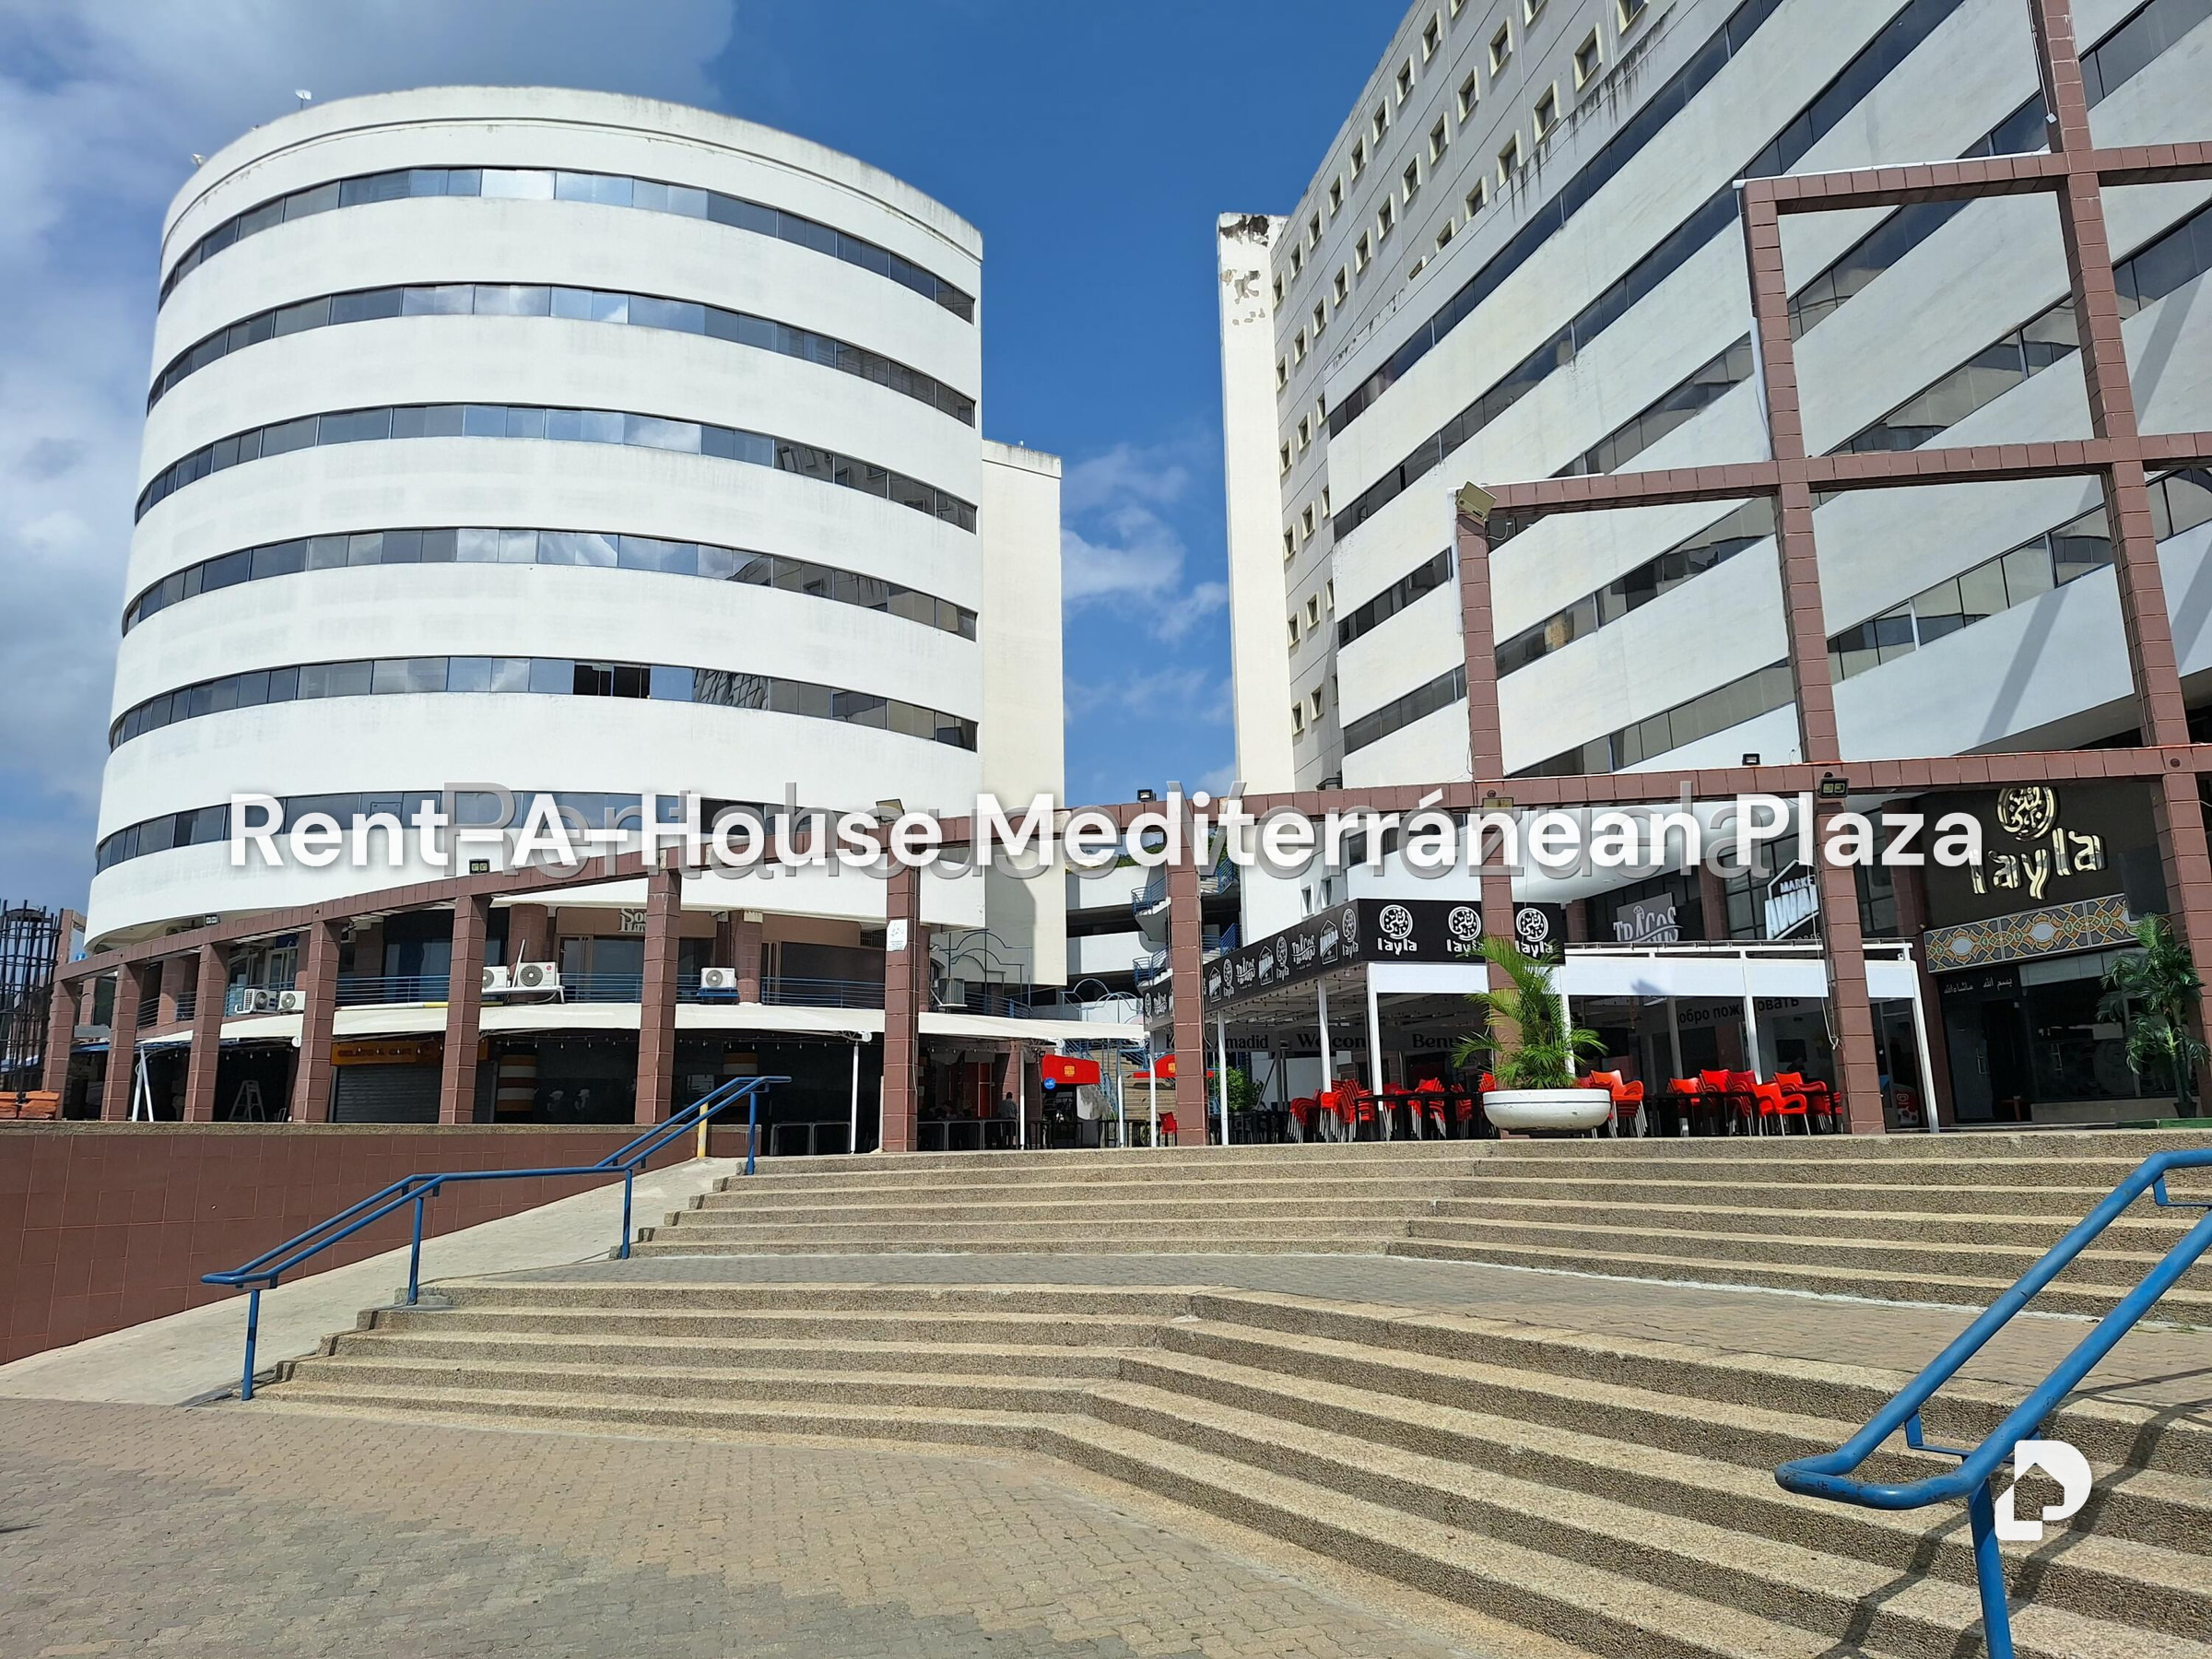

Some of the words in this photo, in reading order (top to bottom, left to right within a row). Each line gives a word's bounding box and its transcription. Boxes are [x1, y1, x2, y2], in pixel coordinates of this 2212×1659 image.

[1779, 875, 1817, 894] MARKE
[1378, 937, 1418, 956] layla
[1678, 1008, 1711, 1025] обро
[1712, 996, 1800, 1018] пожовать
[1215, 1033, 1269, 1049] madid
